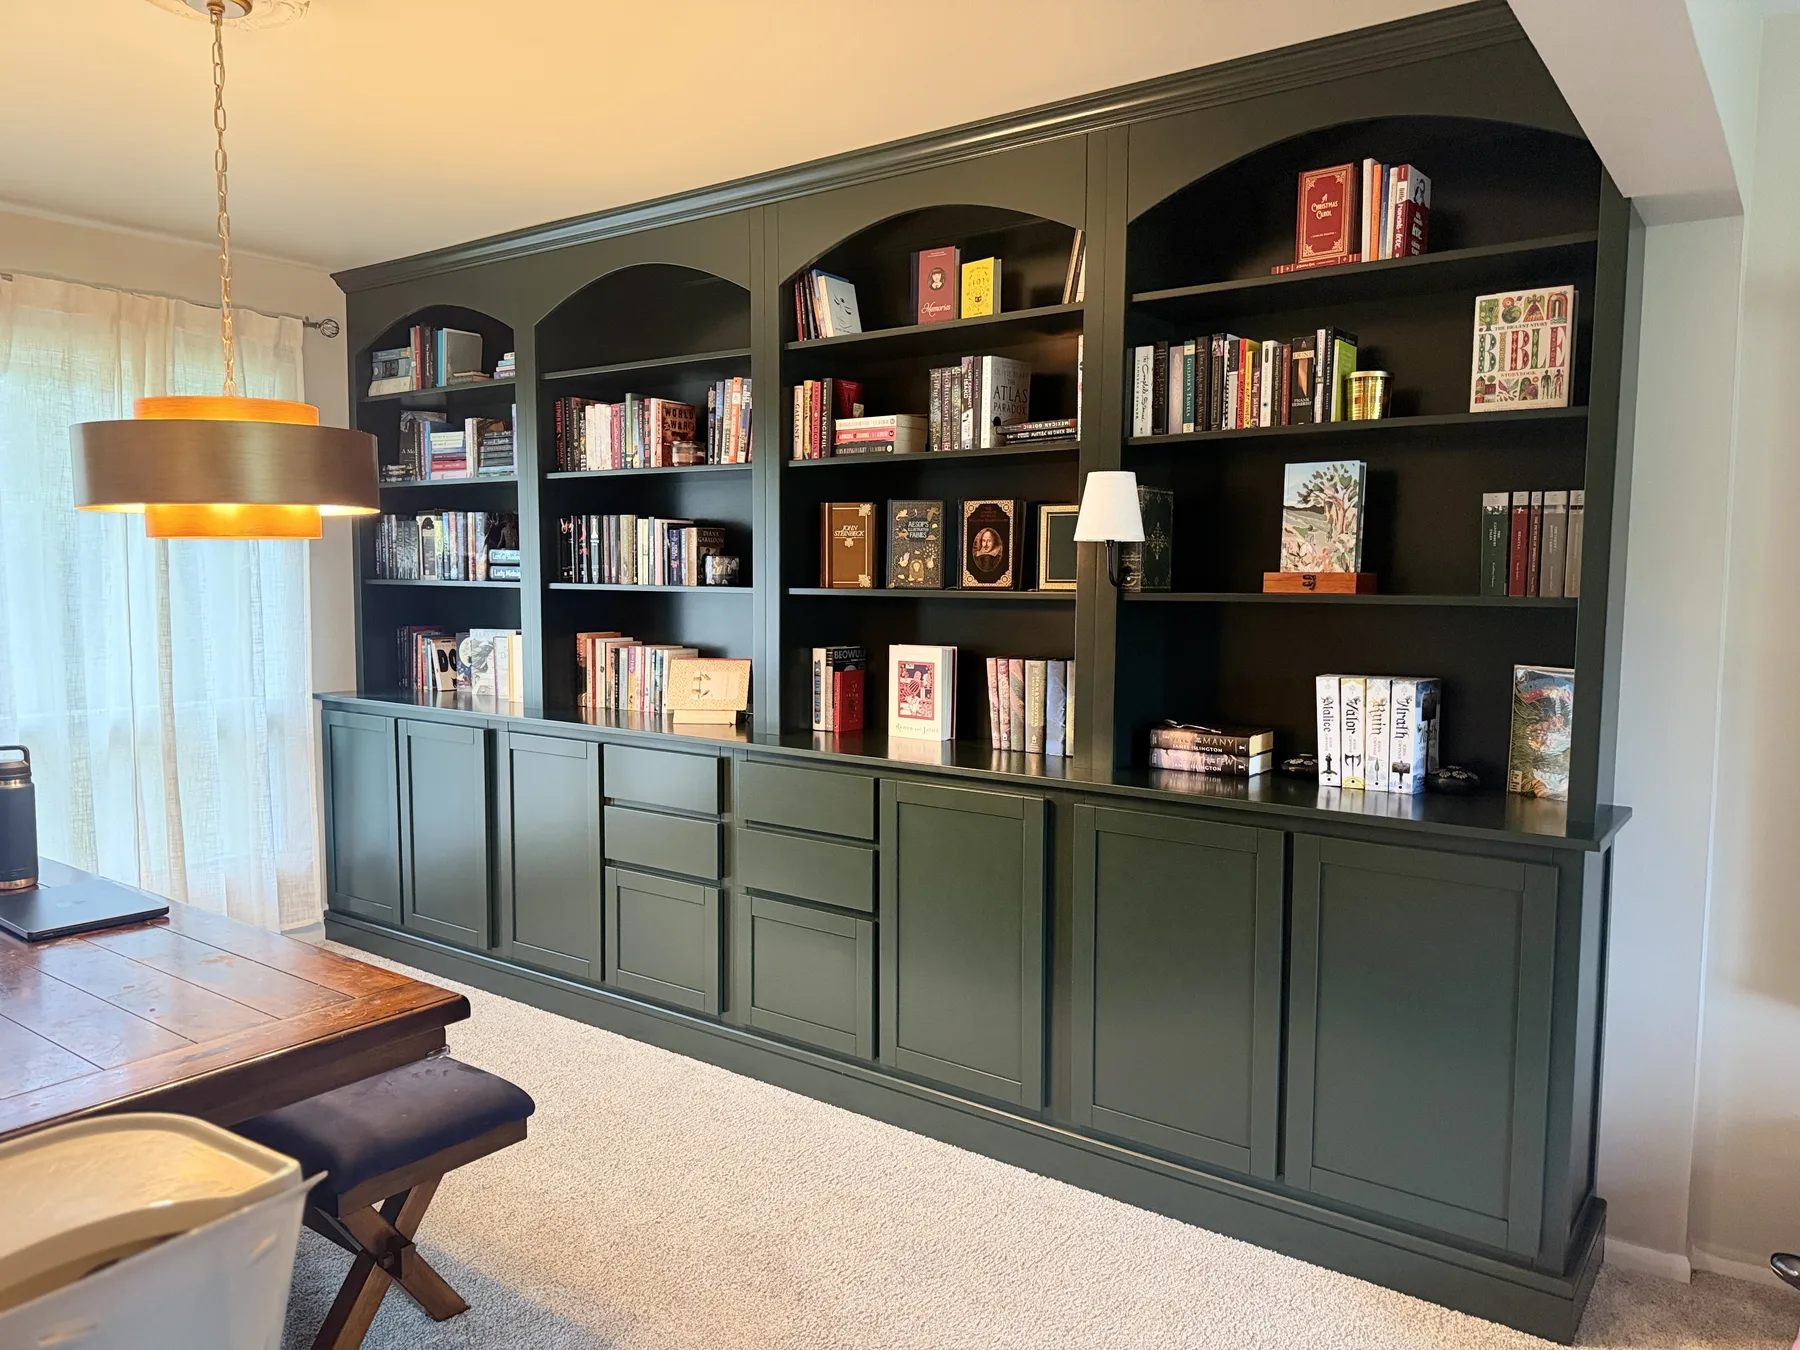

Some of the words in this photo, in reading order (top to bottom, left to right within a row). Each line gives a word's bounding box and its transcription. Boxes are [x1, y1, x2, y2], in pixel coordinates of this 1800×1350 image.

[1311, 201, 1338, 212] CHRISTMAS
[1477, 326, 1567, 374] BIBLE
[994, 385, 1028, 404] ATLAS
[664, 407, 694, 420] WORLD
[994, 402, 1026, 415] PARADOX
[670, 420, 688, 430] WAR
[1321, 696, 1334, 732] Malice
[1346, 696, 1361, 734] Valor
[1368, 698, 1388, 736] Ruin
[1394, 696, 1413, 739] Wrath
[1202, 738, 1234, 747] MANY
